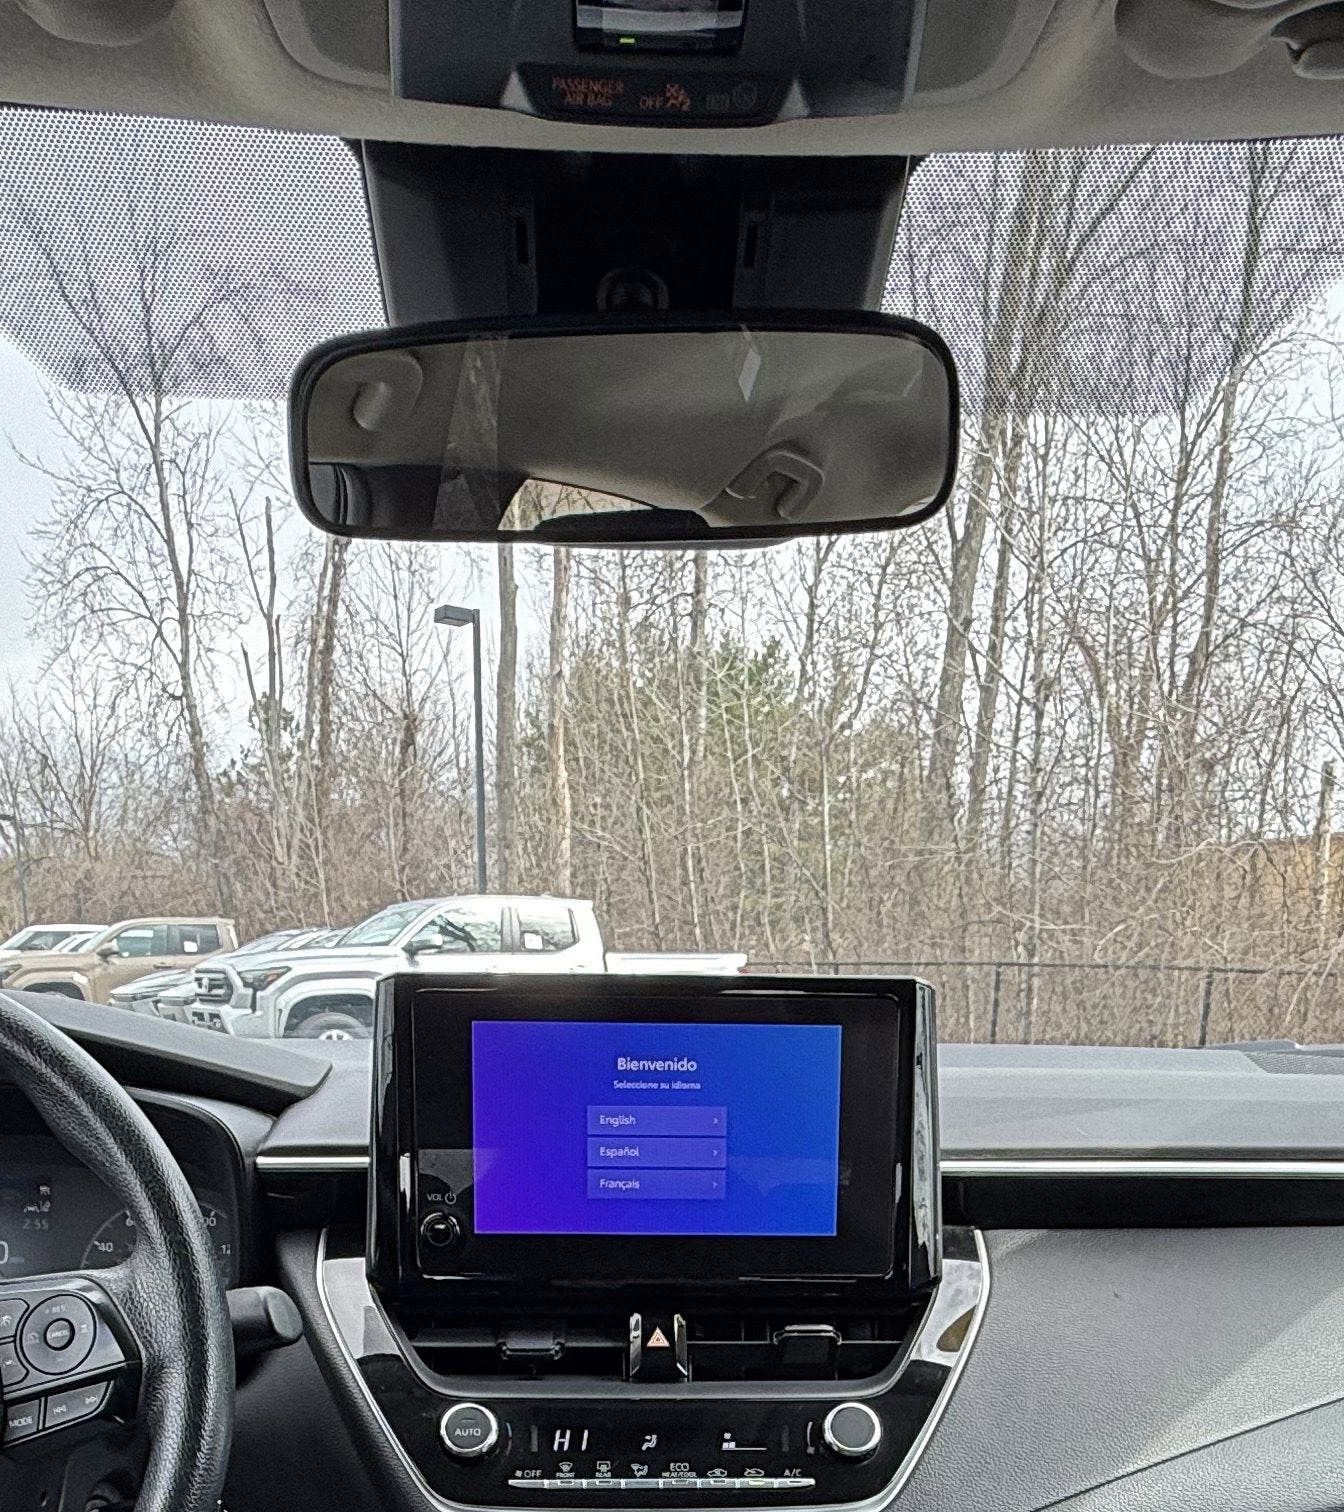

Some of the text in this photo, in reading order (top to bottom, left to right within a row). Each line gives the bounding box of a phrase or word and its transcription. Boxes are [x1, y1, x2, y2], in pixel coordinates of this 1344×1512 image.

[552, 77, 624, 94] PASSENGER
[564, 91, 587, 105] AIR
[617, 1057, 698, 1071] Bienvenido
[613, 1080, 702, 1090] Seleccione su idioma
[599, 1115, 637, 1128] English
[599, 1146, 640, 1159] Español
[599, 1178, 641, 1191] Français
[426, 1193, 443, 1201] VOL
[98, 1242, 114, 1253] 40
[9, 1415, 33, 1428] MODE
[454, 1427, 482, 1437] AUTO
[669, 1462, 690, 1472] ECO
[783, 1467, 803, 1478] A/C
[524, 1469, 543, 1478] OFF
[556, 1471, 576, 1479] FRONT
